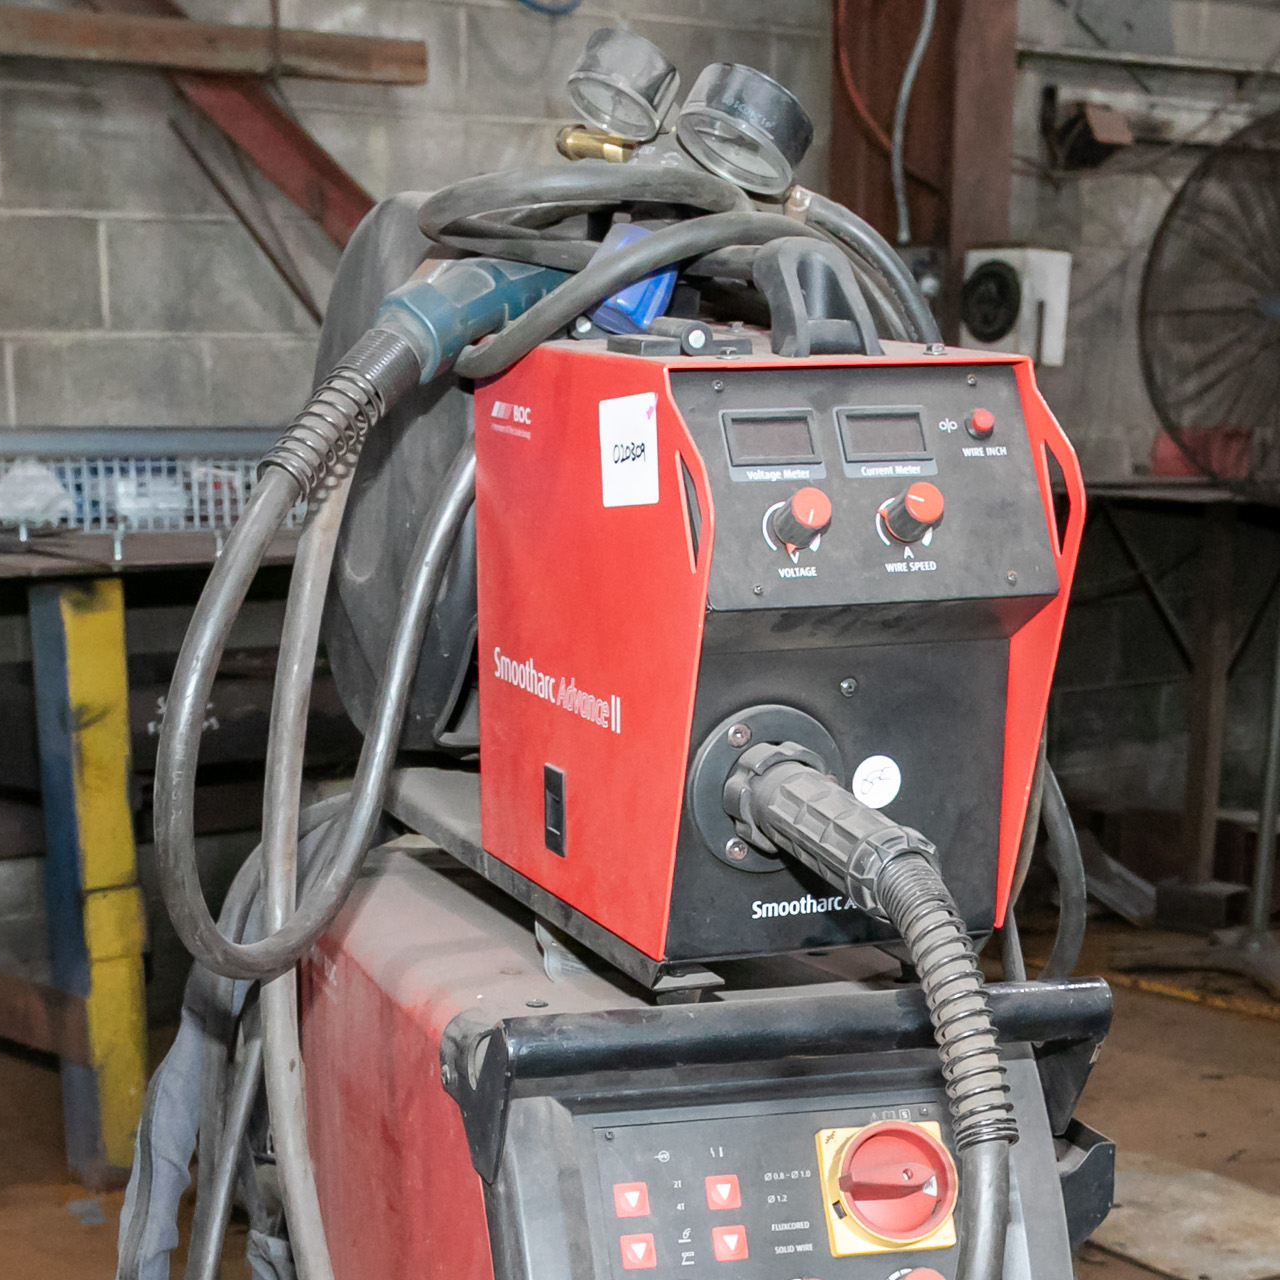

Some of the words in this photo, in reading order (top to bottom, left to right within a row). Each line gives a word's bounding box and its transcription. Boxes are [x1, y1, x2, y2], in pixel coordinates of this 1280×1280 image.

[513, 404, 532, 425] BOC
[961, 447, 985, 458] WIRE
[986, 446, 1008, 457] INCH
[746, 469, 782, 481] Voltage
[782, 469, 811, 479] Meter
[860, 465, 894, 477] Current
[895, 464, 922, 475] Meter
[790, 551, 800, 565] V
[903, 546, 915, 560] A
[778, 566, 818, 579] VOLTAGE
[885, 562, 909, 574] WIRE
[909, 560, 937, 572] SPEED
[493, 646, 556, 704] Smootharc
[556, 676, 610, 729] Advance
[751, 893, 843, 920] Smootharc
[773, 1171, 785, 1181] 0.8
[800, 1169, 812, 1178] 1.0
[673, 1180, 682, 1189] 2T
[776, 1194, 788, 1203] 1.2
[676, 1202, 685, 1211] 4T
[771, 1221, 810, 1232] FLUXCORED
[774, 1245, 795, 1255] SOLID
[795, 1243, 813, 1252] WIRE
